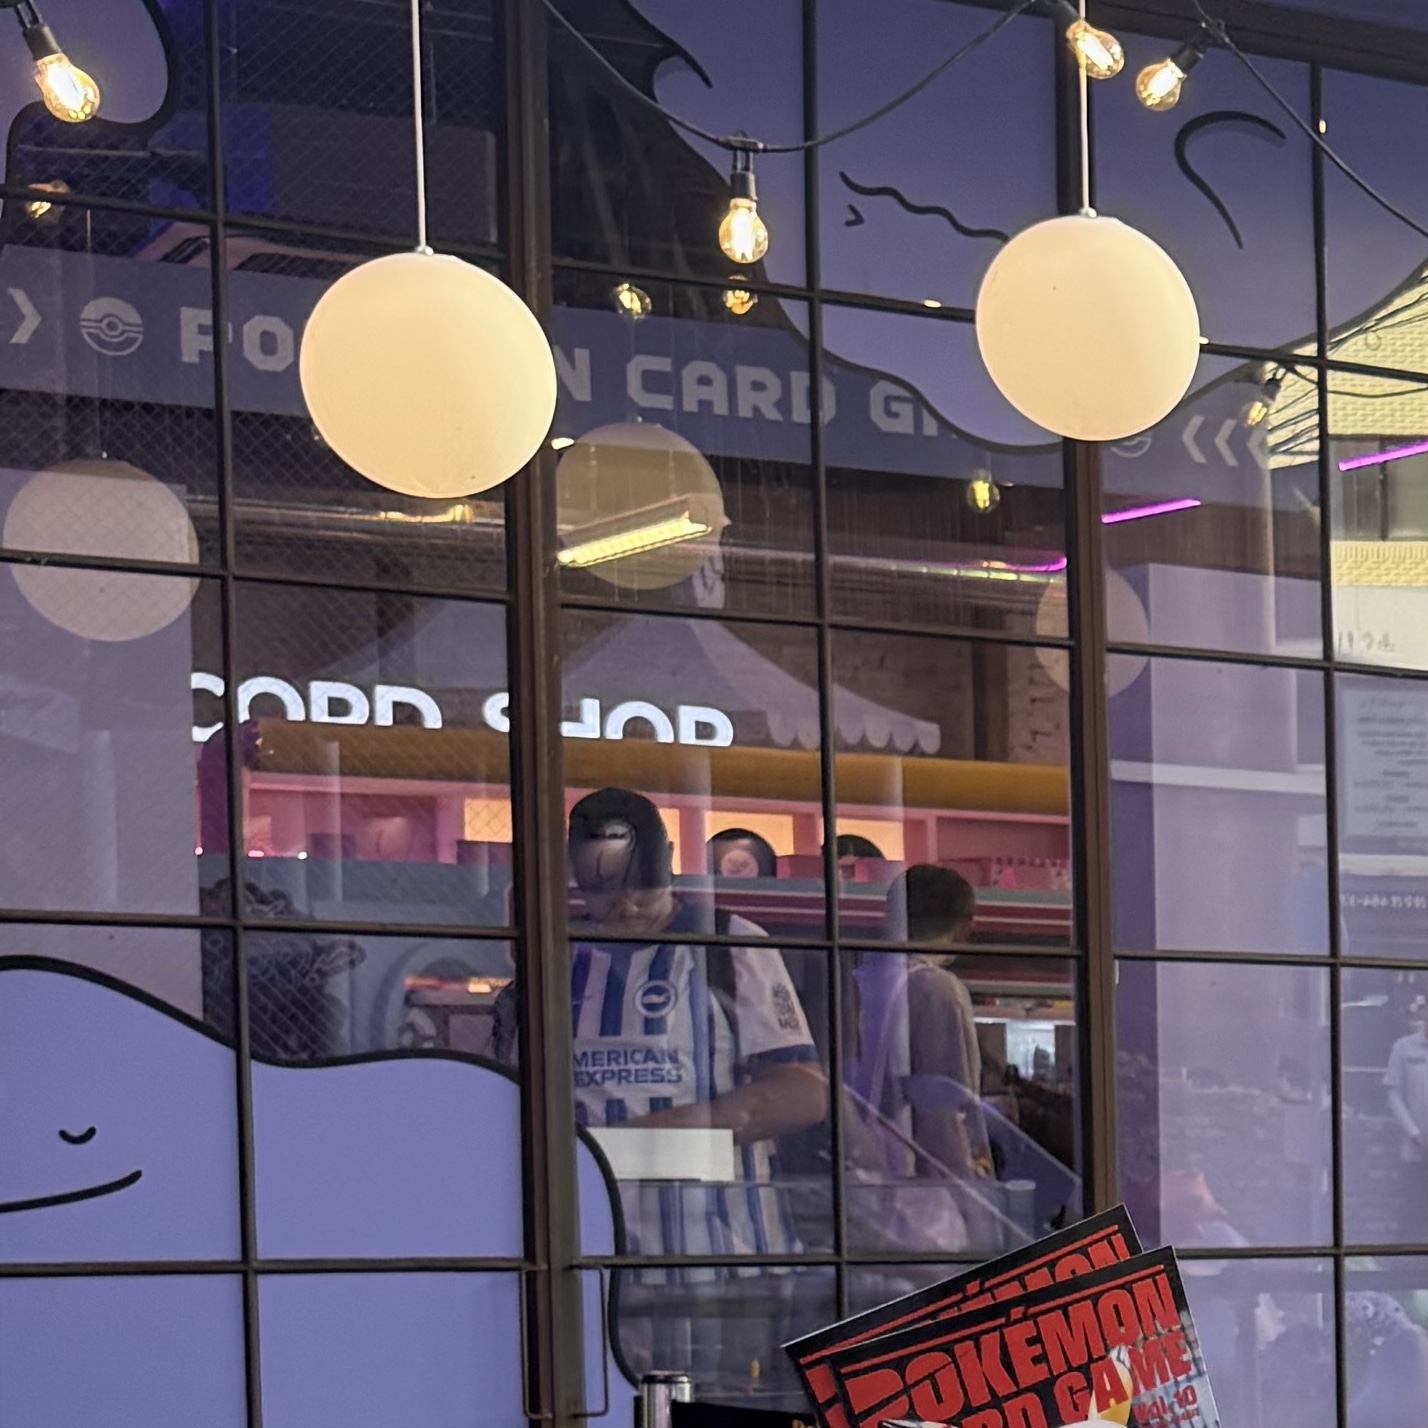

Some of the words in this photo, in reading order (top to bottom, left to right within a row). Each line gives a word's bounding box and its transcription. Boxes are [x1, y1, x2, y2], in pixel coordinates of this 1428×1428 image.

[626, 355, 836, 429] CARD
[574, 1048, 681, 1069] MERICAN
[574, 1067, 683, 1087] EXPRESS
[1052, 1331, 1192, 1424] GAME
